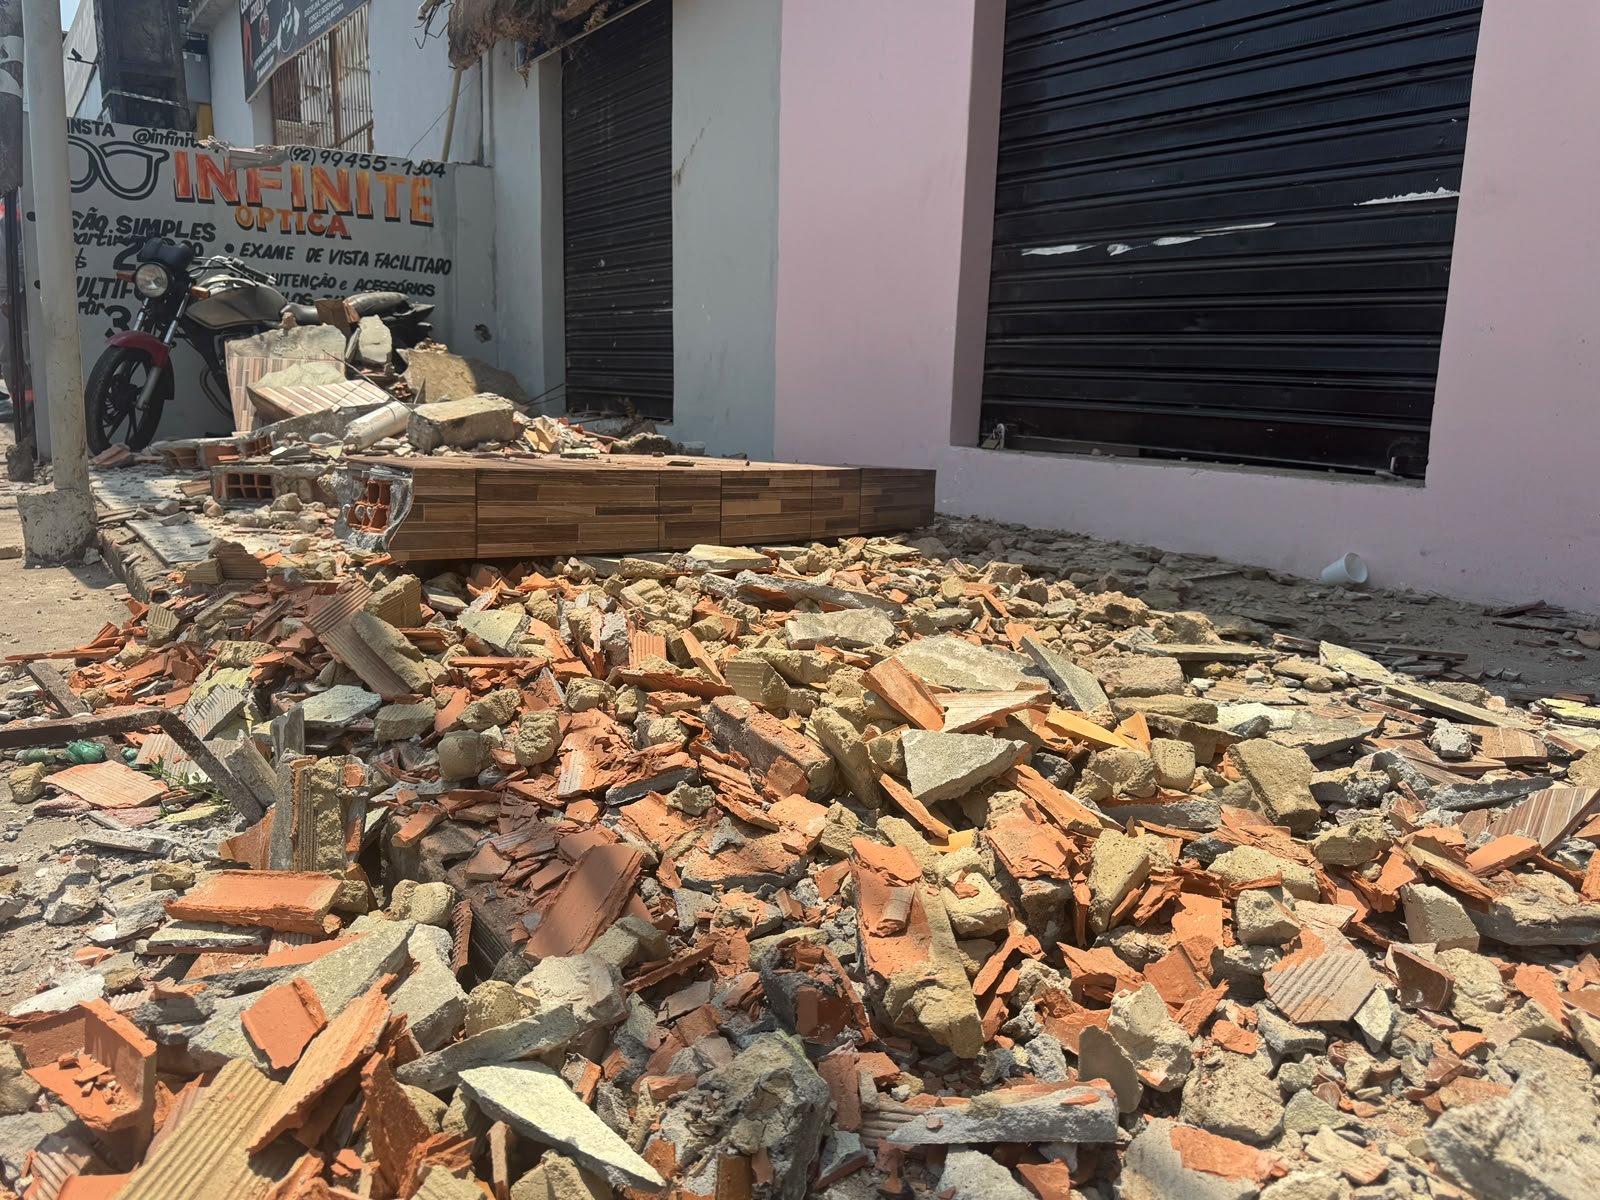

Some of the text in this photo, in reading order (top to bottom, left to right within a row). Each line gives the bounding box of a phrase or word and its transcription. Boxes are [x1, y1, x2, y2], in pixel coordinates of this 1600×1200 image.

[66, 117, 115, 137] INSTA
[290, 146, 316, 165] (92)
[173, 151, 434, 227] INFINITE
[72, 207, 216, 243] SÃO SIMPLES
[240, 242, 452, 276] EXAME DE VISTA FACILITADO
[339, 280, 348, 291] e
